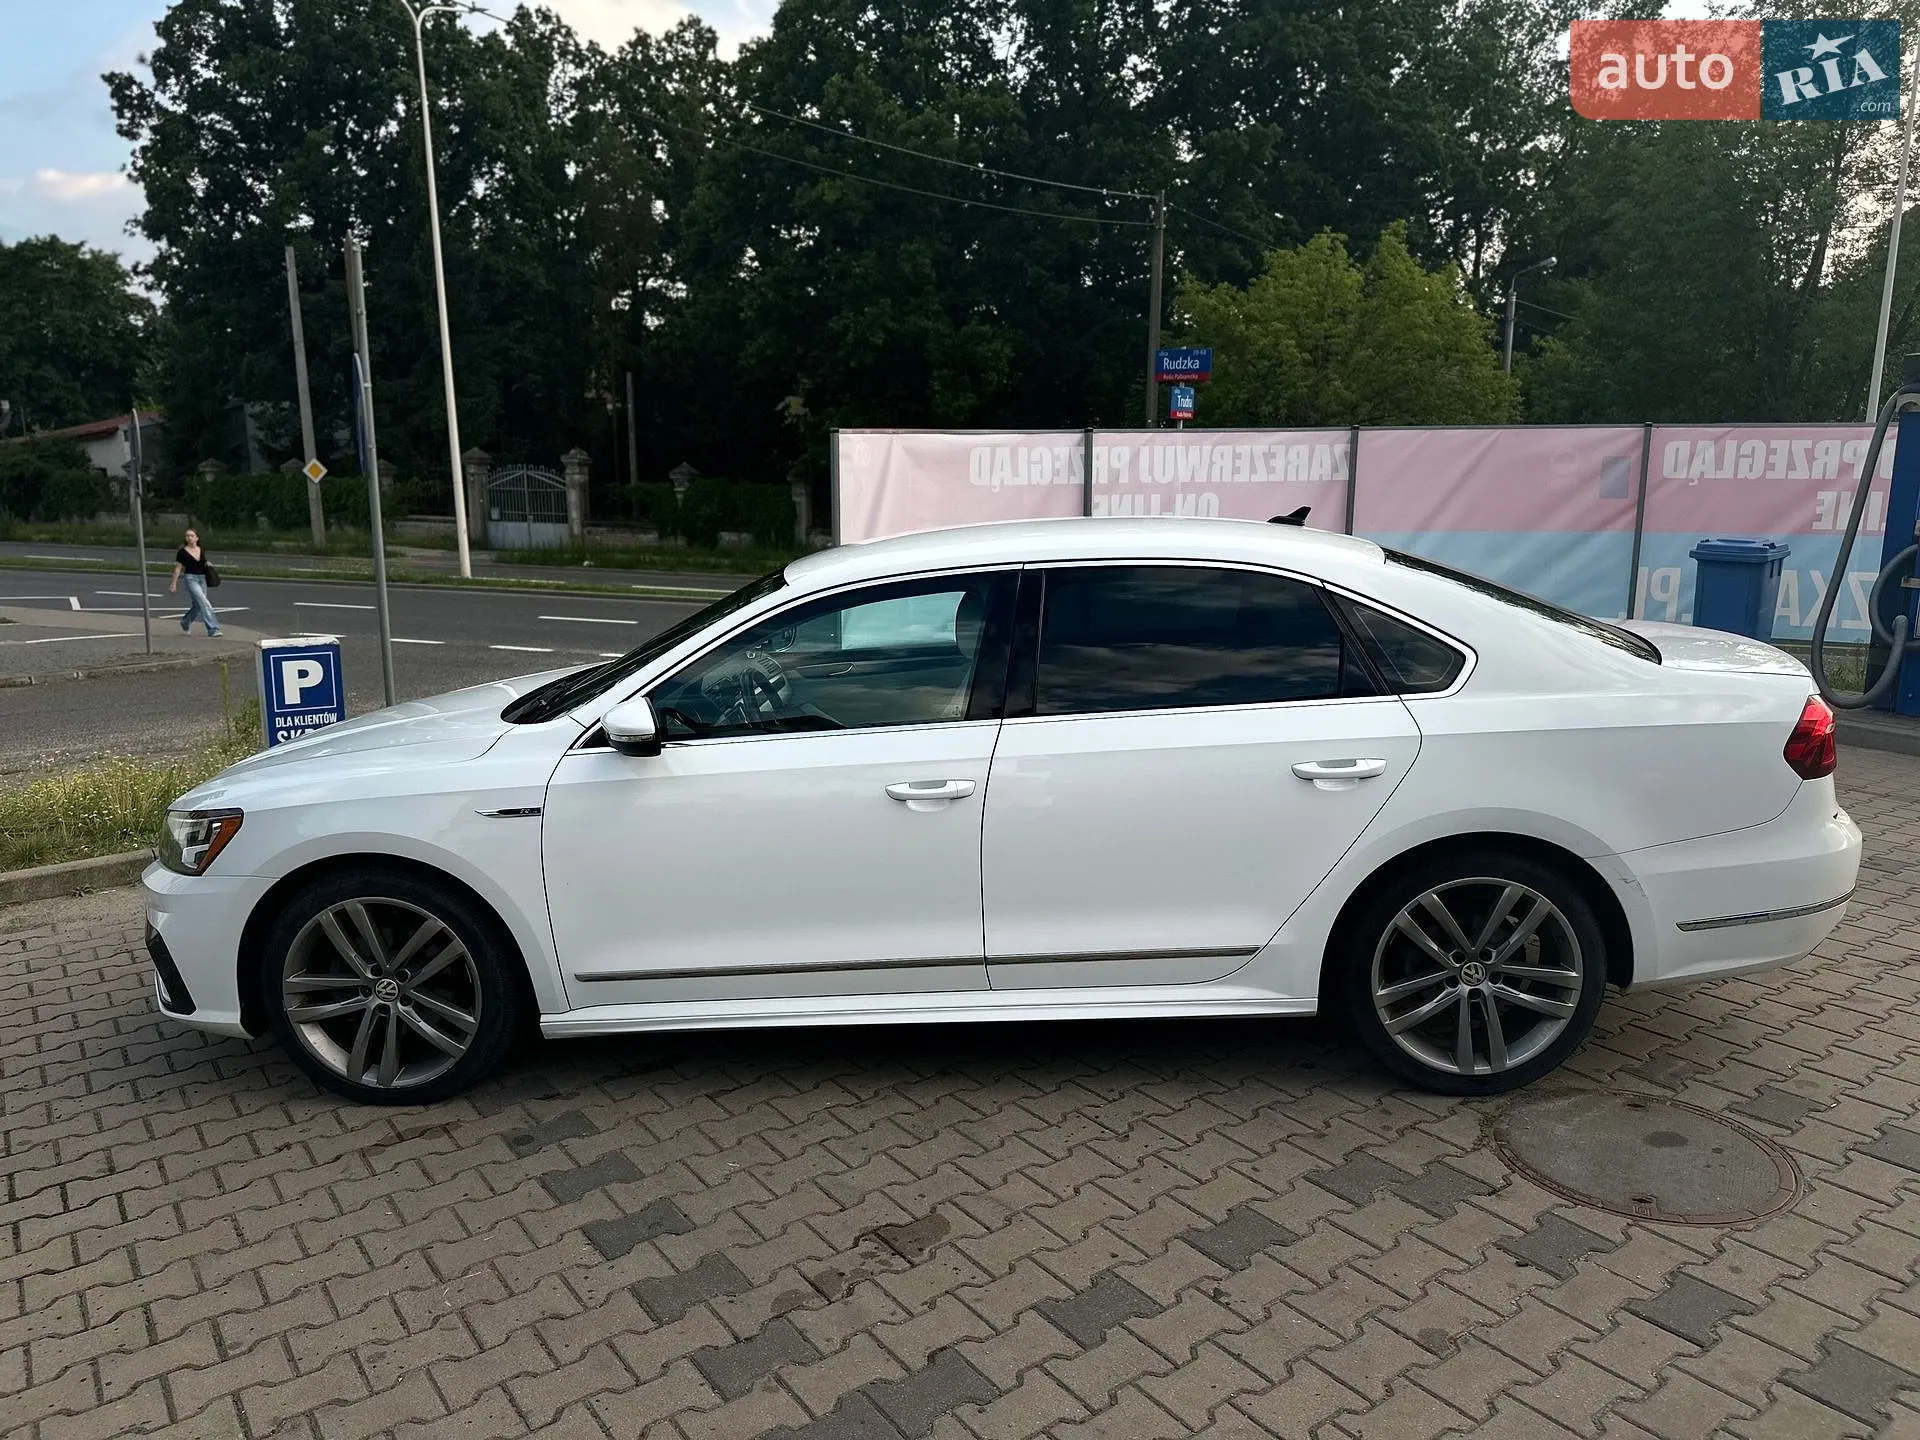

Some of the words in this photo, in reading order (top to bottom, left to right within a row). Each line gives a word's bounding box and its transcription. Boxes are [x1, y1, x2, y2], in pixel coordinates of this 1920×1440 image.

[1163, 357, 1199, 370] Rudzka
[282, 659, 324, 705] P
[275, 716, 293, 728] DLA
[294, 712, 337, 726] KLIENTÓW
